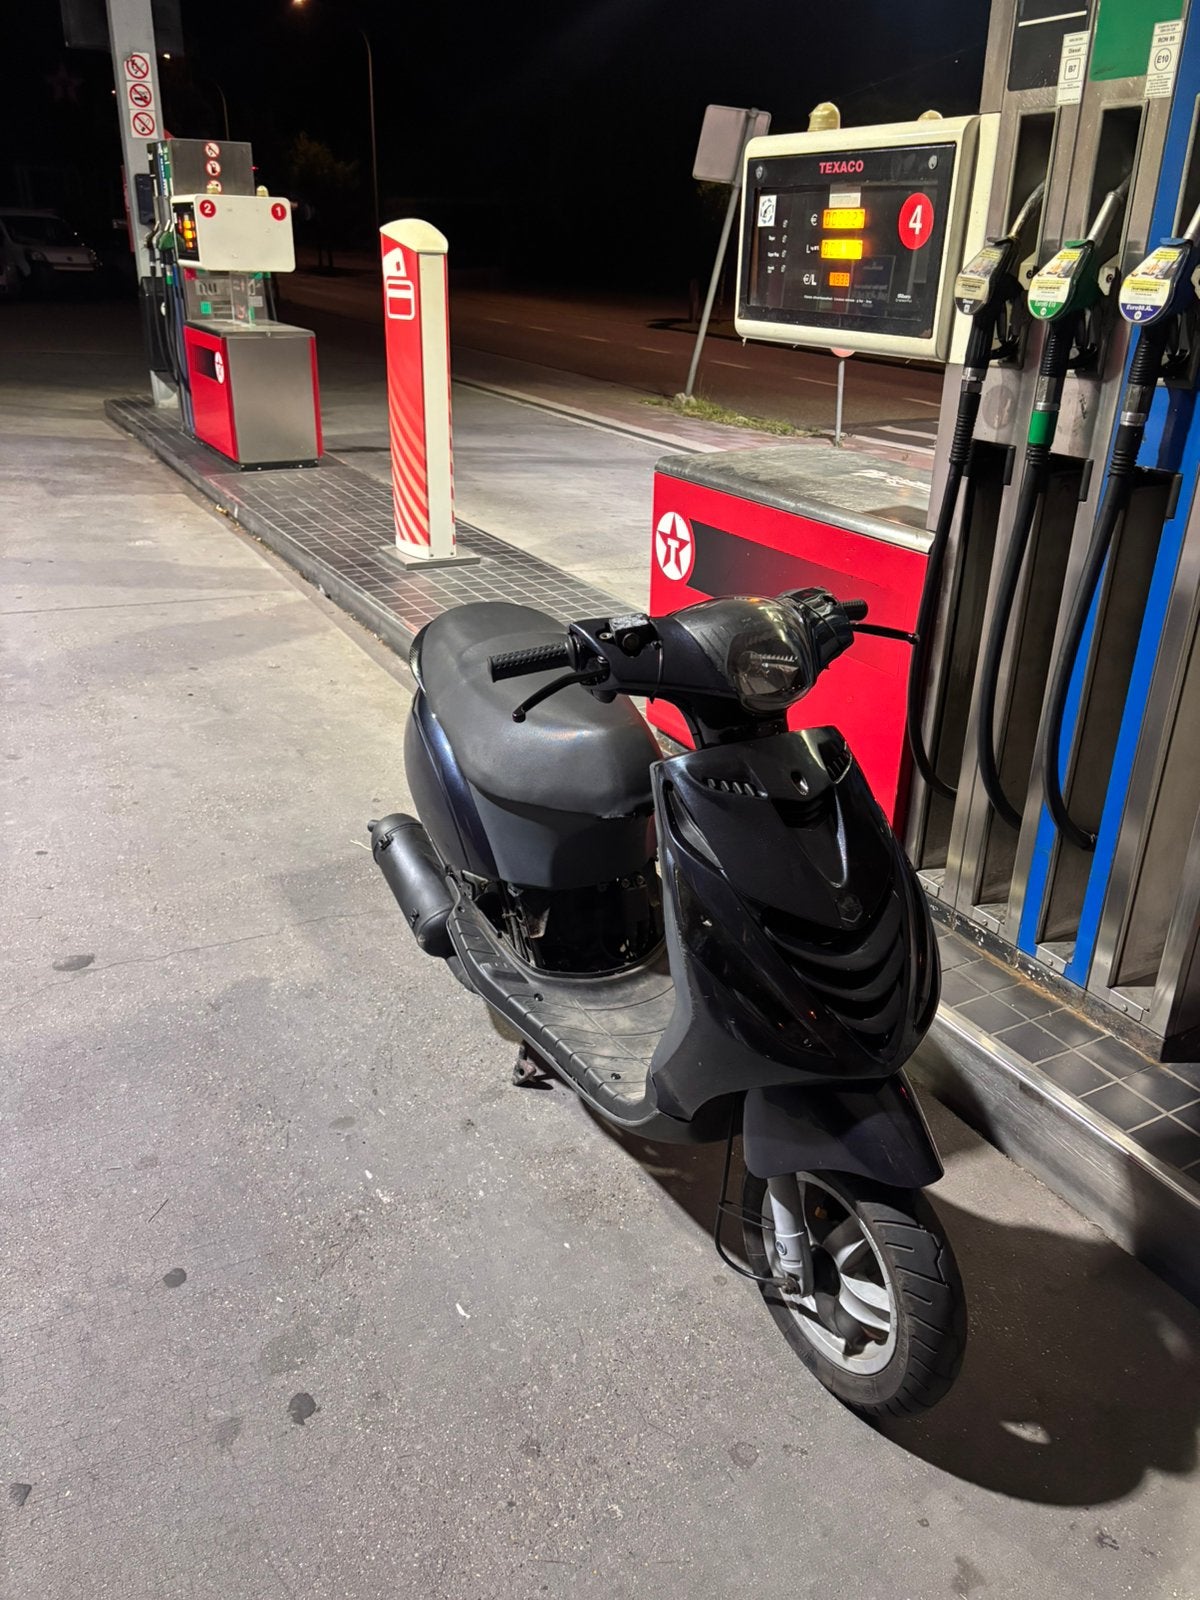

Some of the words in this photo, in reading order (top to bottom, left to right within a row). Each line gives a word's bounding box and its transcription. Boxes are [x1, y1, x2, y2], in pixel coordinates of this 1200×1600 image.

[1156, 54, 1169, 64] E10
[1068, 64, 1077, 73] B7
[819, 159, 865, 174] TEXACO
[203, 202, 212, 214] 2
[275, 206, 282, 217] 1
[810, 213, 818, 226] €
[909, 205, 922, 235] 4
[802, 273, 817, 286] €/L
